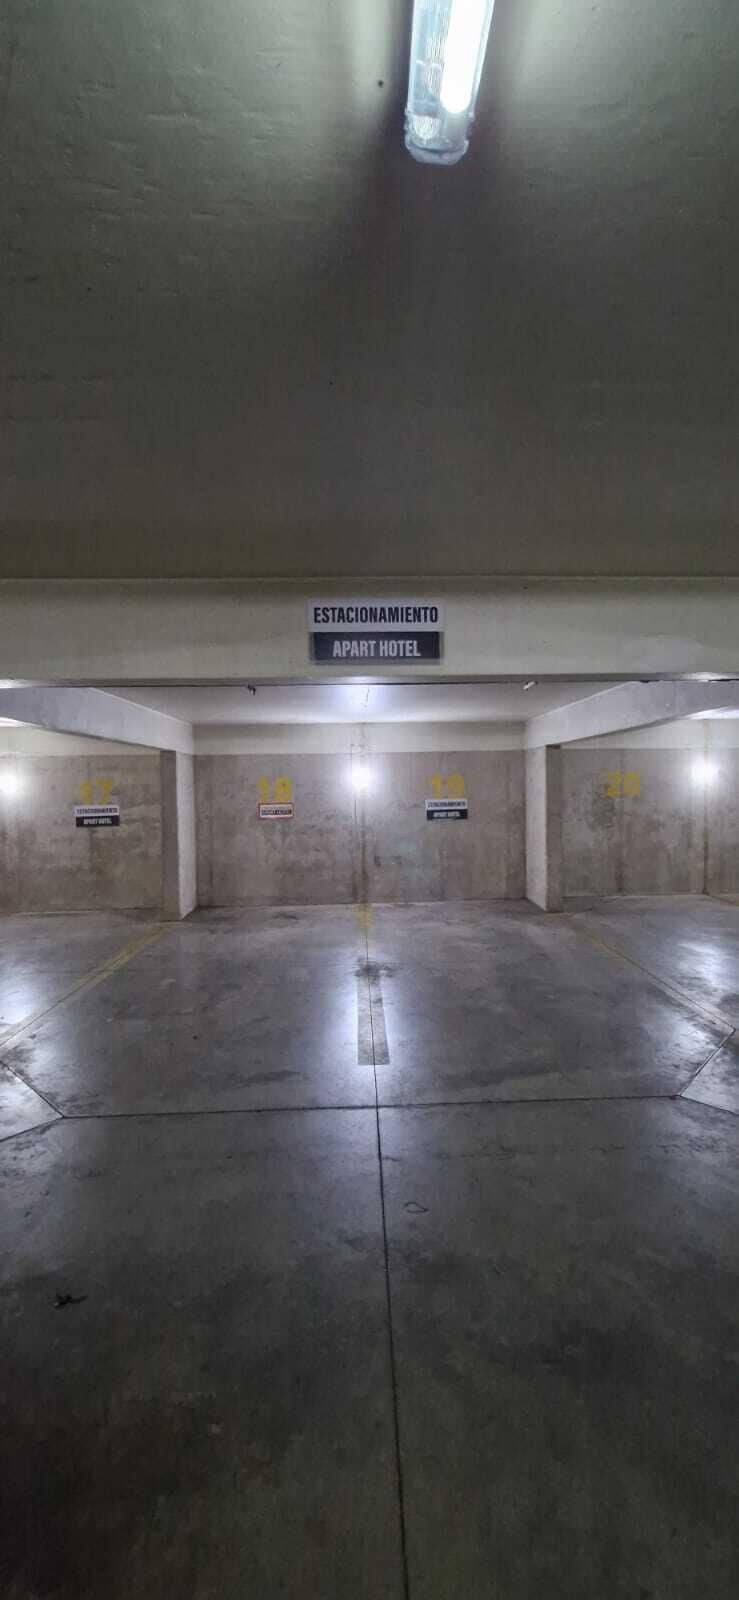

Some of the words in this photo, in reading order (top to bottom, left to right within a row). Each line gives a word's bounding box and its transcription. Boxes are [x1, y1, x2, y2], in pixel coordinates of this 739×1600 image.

[313, 606, 439, 624] ESTACIONAMIENTO
[332, 640, 376, 657] APART
[379, 640, 421, 657] HOTEL
[81, 778, 113, 804] 17
[258, 776, 293, 802] 18
[607, 771, 641, 797] 20
